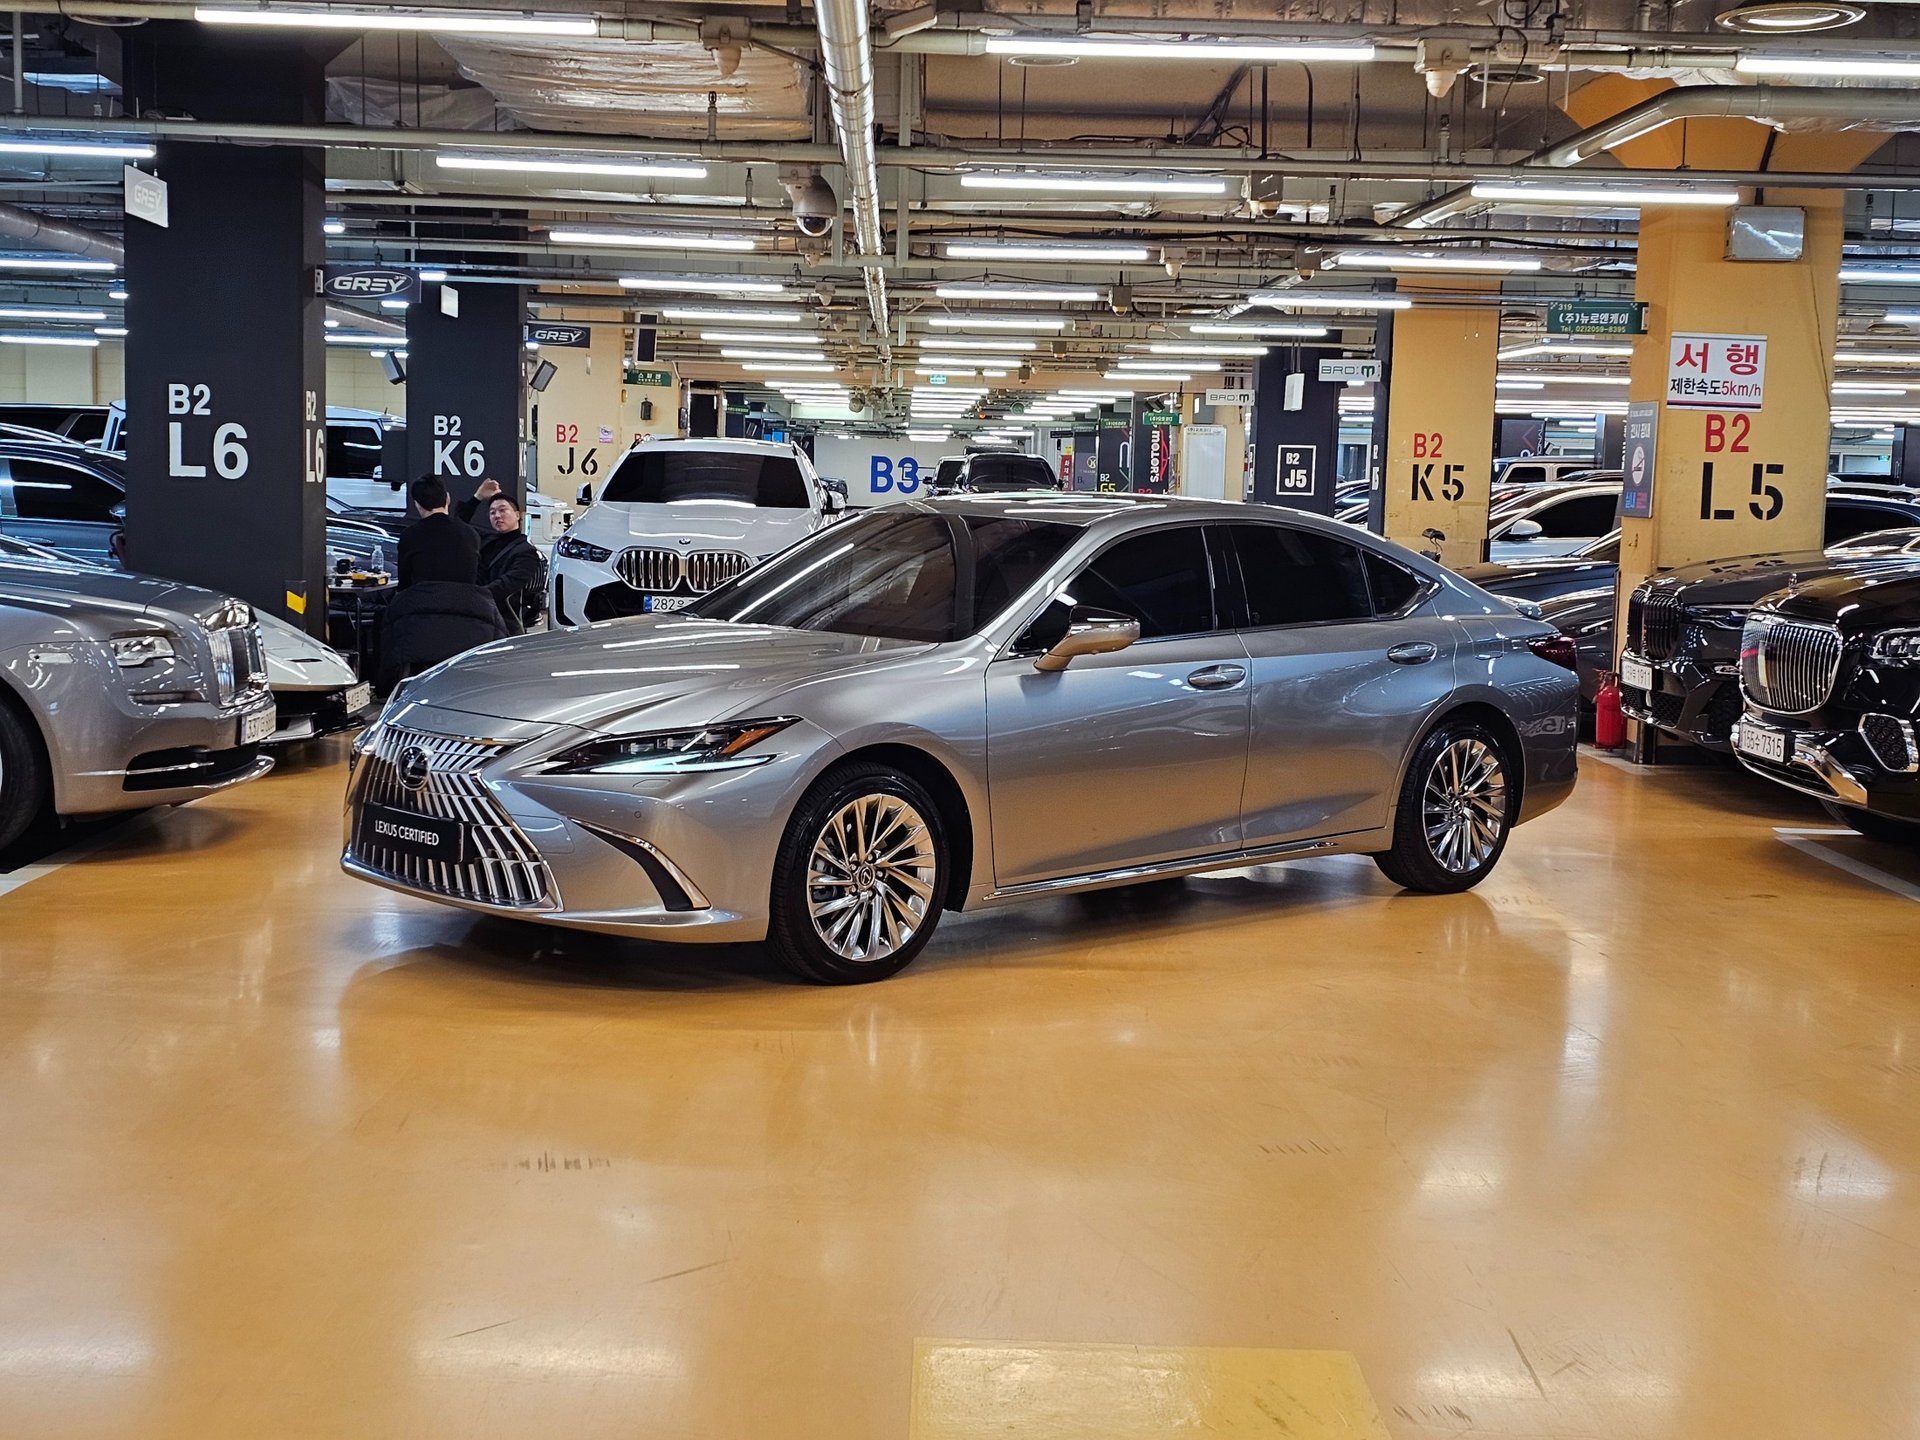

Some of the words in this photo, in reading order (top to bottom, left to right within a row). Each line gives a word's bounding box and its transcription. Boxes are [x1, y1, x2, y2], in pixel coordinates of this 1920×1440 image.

[334, 276, 404, 292] GREY
[535, 330, 580, 342] GREY
[168, 383, 211, 415] B2
[305, 390, 316, 421] B2
[434, 415, 461, 436] B2
[556, 424, 578, 443] B2
[1705, 413, 1751, 452] B2
[169, 421, 249, 480] L6
[305, 428, 325, 483] L6
[434, 440, 485, 477] K6
[1286, 453, 1300, 465] B2
[1413, 432, 1443, 458] B2
[557, 447, 598, 476] J6
[870, 455, 919, 494] B3
[1284, 469, 1307, 488] J5
[1411, 464, 1465, 501] K5
[375, 820, 398, 837] LEXUS
[398, 826, 440, 846] CERTIFIED
